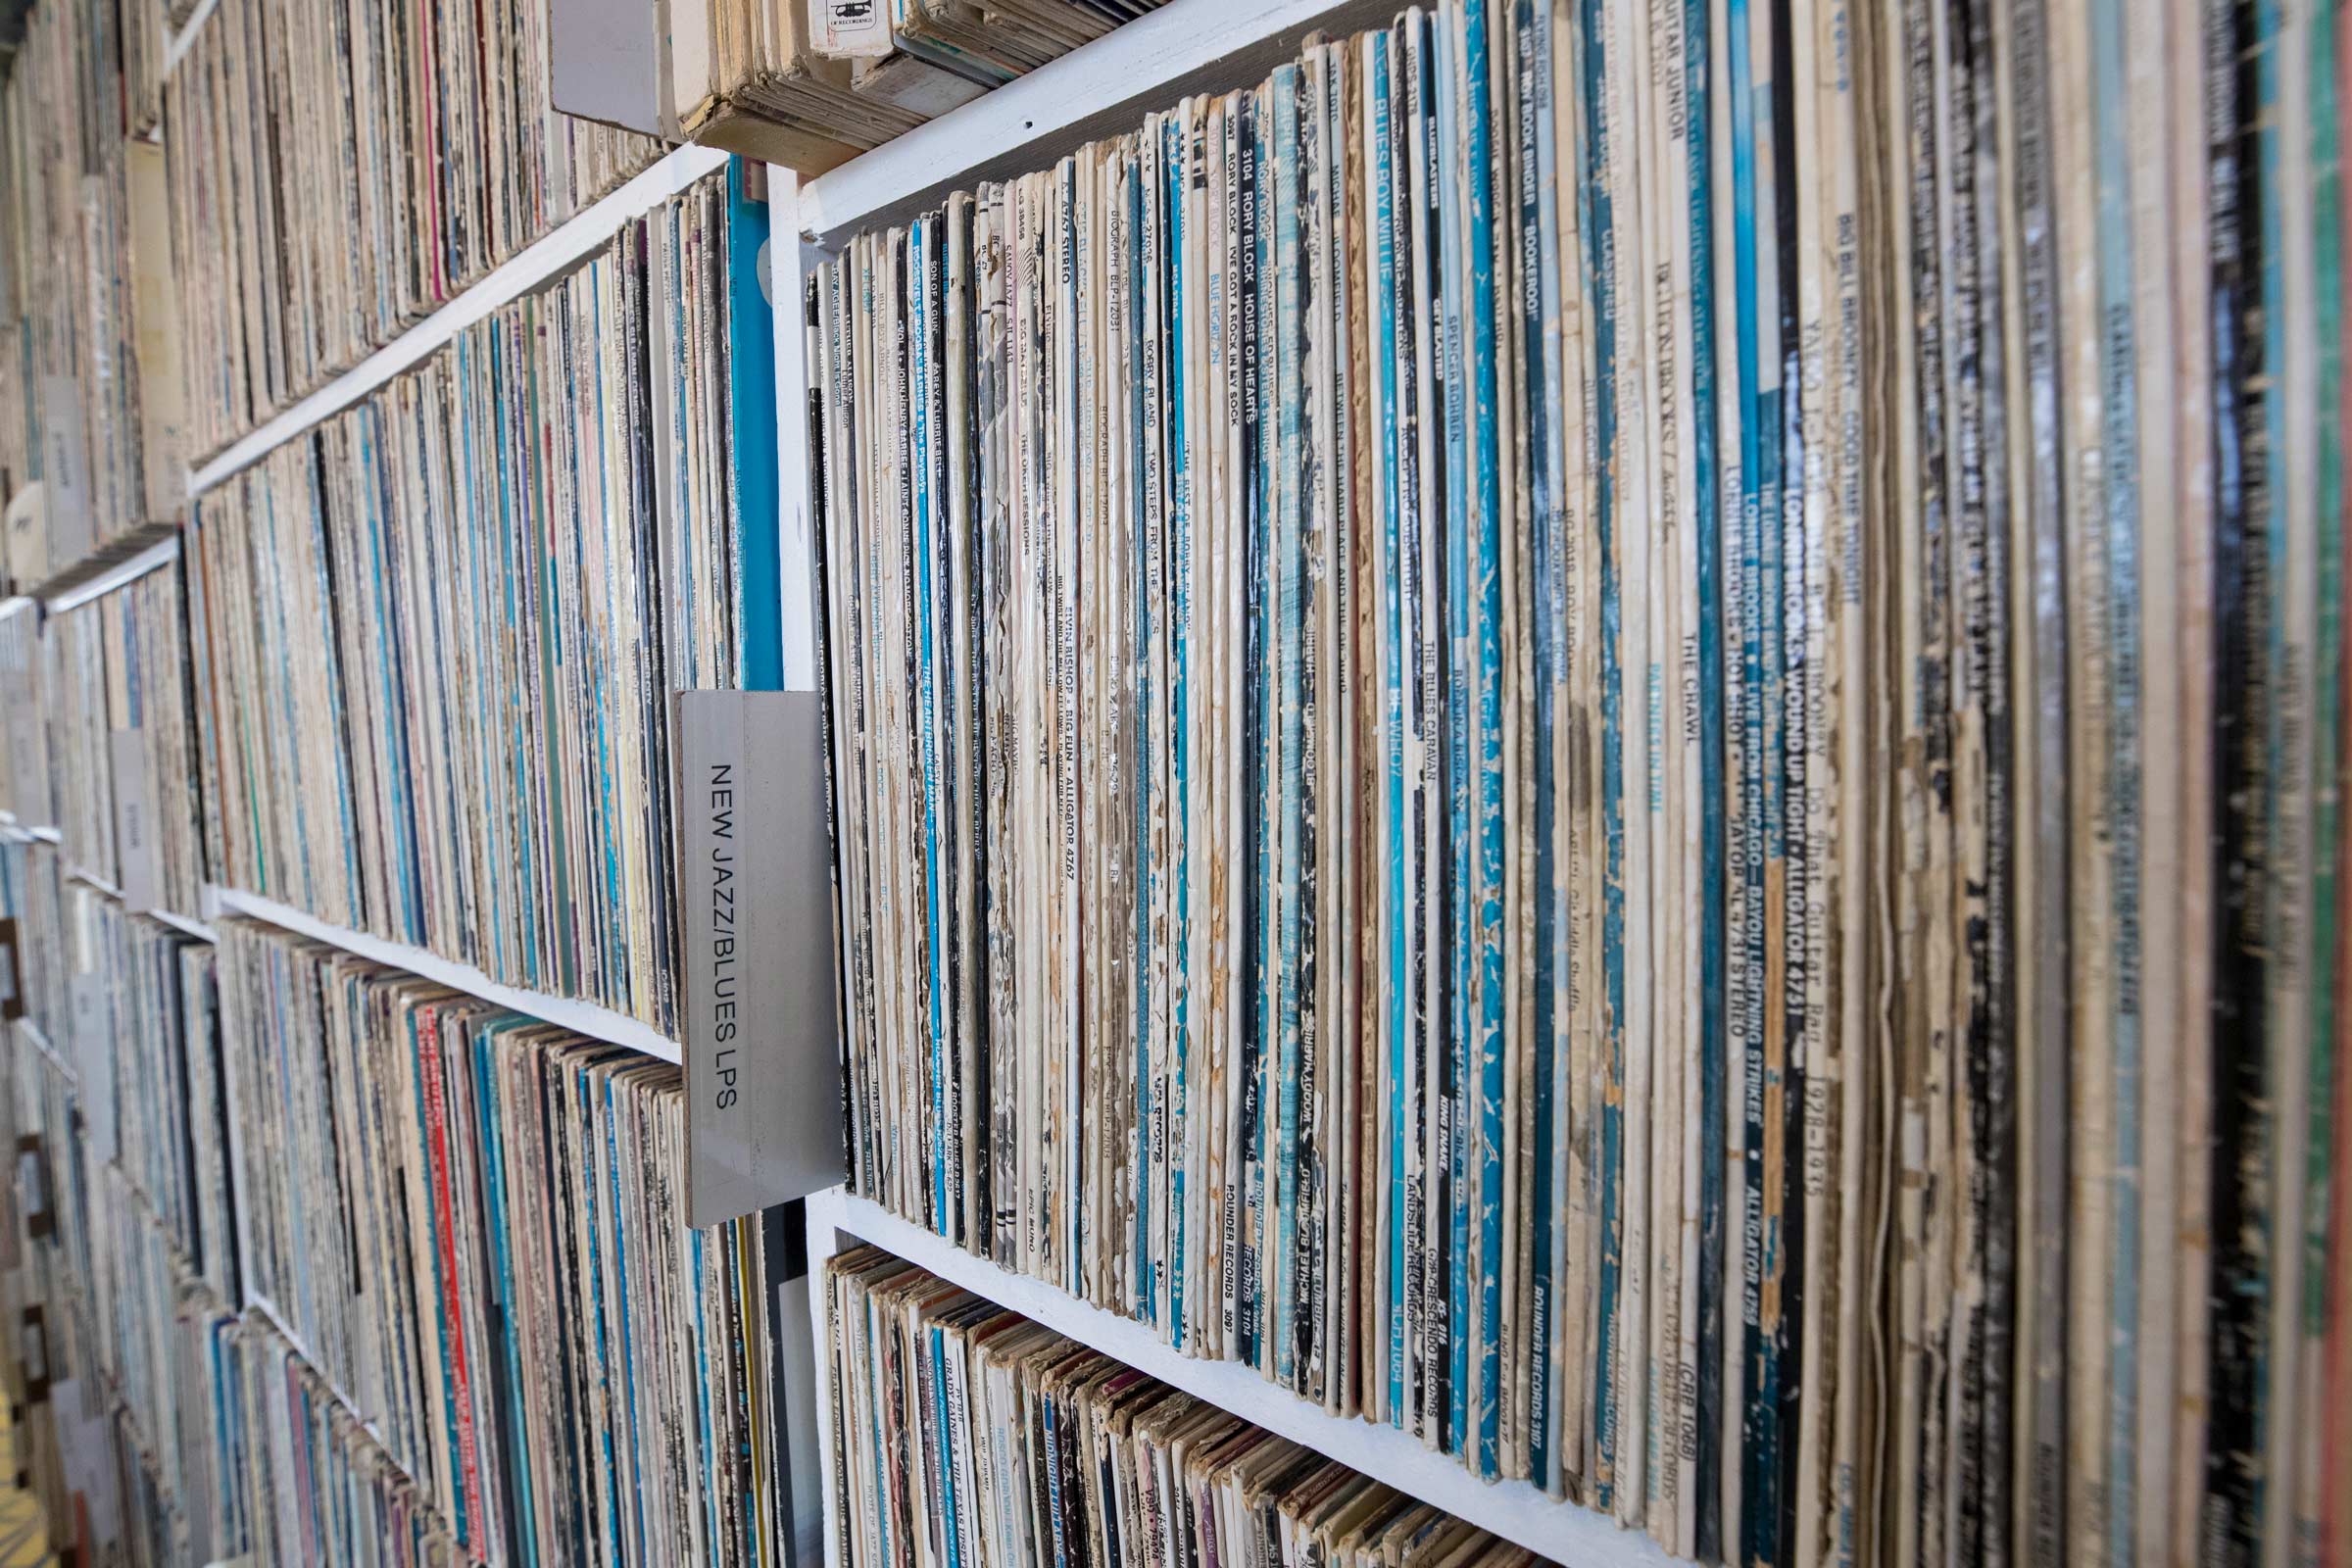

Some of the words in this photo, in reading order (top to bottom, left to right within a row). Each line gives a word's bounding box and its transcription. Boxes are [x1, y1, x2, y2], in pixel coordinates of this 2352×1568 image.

[1521, 71, 1532, 99] ROY
[1666, 68, 1685, 141] JUNIOR
[1375, 98, 1388, 165] BLUES
[1522, 103, 1533, 147] BOOK
[1243, 148, 1252, 180] 3104
[1377, 170, 1389, 211] BOY
[1522, 150, 1534, 206] BINDER
[1243, 191, 1252, 232] RORY
[1837, 213, 1854, 245] BIG
[1244, 235, 1253, 283] BLOCK
[1525, 218, 1539, 321] "BOOKEROO!"
[1838, 251, 1856, 294] BILL
[931, 283, 938, 296] OF
[1210, 274, 1220, 303] BLUE
[1211, 305, 1221, 365] HORIZON
[1229, 315, 1238, 350] ROCK
[1245, 294, 1254, 342] HOUSE
[1230, 355, 1237, 367] IN
[1245, 345, 1254, 366] OF
[1434, 326, 1444, 380] BLASTED
[1448, 316, 1459, 381] SPENCER
[1230, 370, 1238, 389] MY
[1245, 368, 1255, 425] HEARTS
[1449, 384, 1459, 442] BOHREN
[1745, 565, 1757, 645] BROOKS
[1424, 641, 1435, 666] THE
[1685, 634, 1697, 671] THE
[1425, 671, 1436, 715] BLUES
[1453, 669, 1463, 707] BORN
[1686, 678, 1698, 747] CRAWL
[1745, 682, 1759, 723] LIVE
[1786, 669, 1803, 753] WOUND
[925, 690, 934, 782] HEARTBROKEN
[1390, 719, 1401, 777] WHO?
[1426, 719, 1436, 781] CARAVAN
[1647, 752, 1662, 771] IN
[1745, 727, 1760, 780] FROM
[1787, 755, 1804, 782] UP
[710, 764, 732, 839] NEW
[1787, 785, 1804, 845] TIGHT
[1787, 855, 1804, 964] ALLIGATOR
[711, 848, 737, 1043] JAZZ/BLUES
[1807, 901, 1825, 988] Guitar
[1732, 964, 1745, 1037] STEREO
[1748, 948, 1761, 1044] LIGHTNING
[715, 1050, 738, 1110] LPS
[1303, 1076, 1312, 1123] WOODY
[1747, 1050, 1761, 1124] STRIKES
[1440, 1095, 1448, 1126] KING
[1439, 1127, 1448, 1172] SNAKE
[1226, 1185, 1235, 1241] ROUNDER
[1407, 1175, 1416, 1253] LANDSLIDE
[1745, 1185, 1759, 1284] ALLIGATOR
[1225, 1244, 1235, 1299] RECORDS
[1243, 1245, 1252, 1302] RECORDS
[1300, 1250, 1310, 1304] MICHAEL
[1407, 1256, 1416, 1322] RECORDS
[1244, 1308, 1252, 1336] 3104
[1427, 1277, 1437, 1353] CRESCENDO
[1533, 1286, 1544, 1349] ROUNDER
[1532, 1353, 1543, 1417] RECORDS
[1045, 1429, 1056, 1493] MIDNIGHT
[1531, 1421, 1541, 1448] 3107
